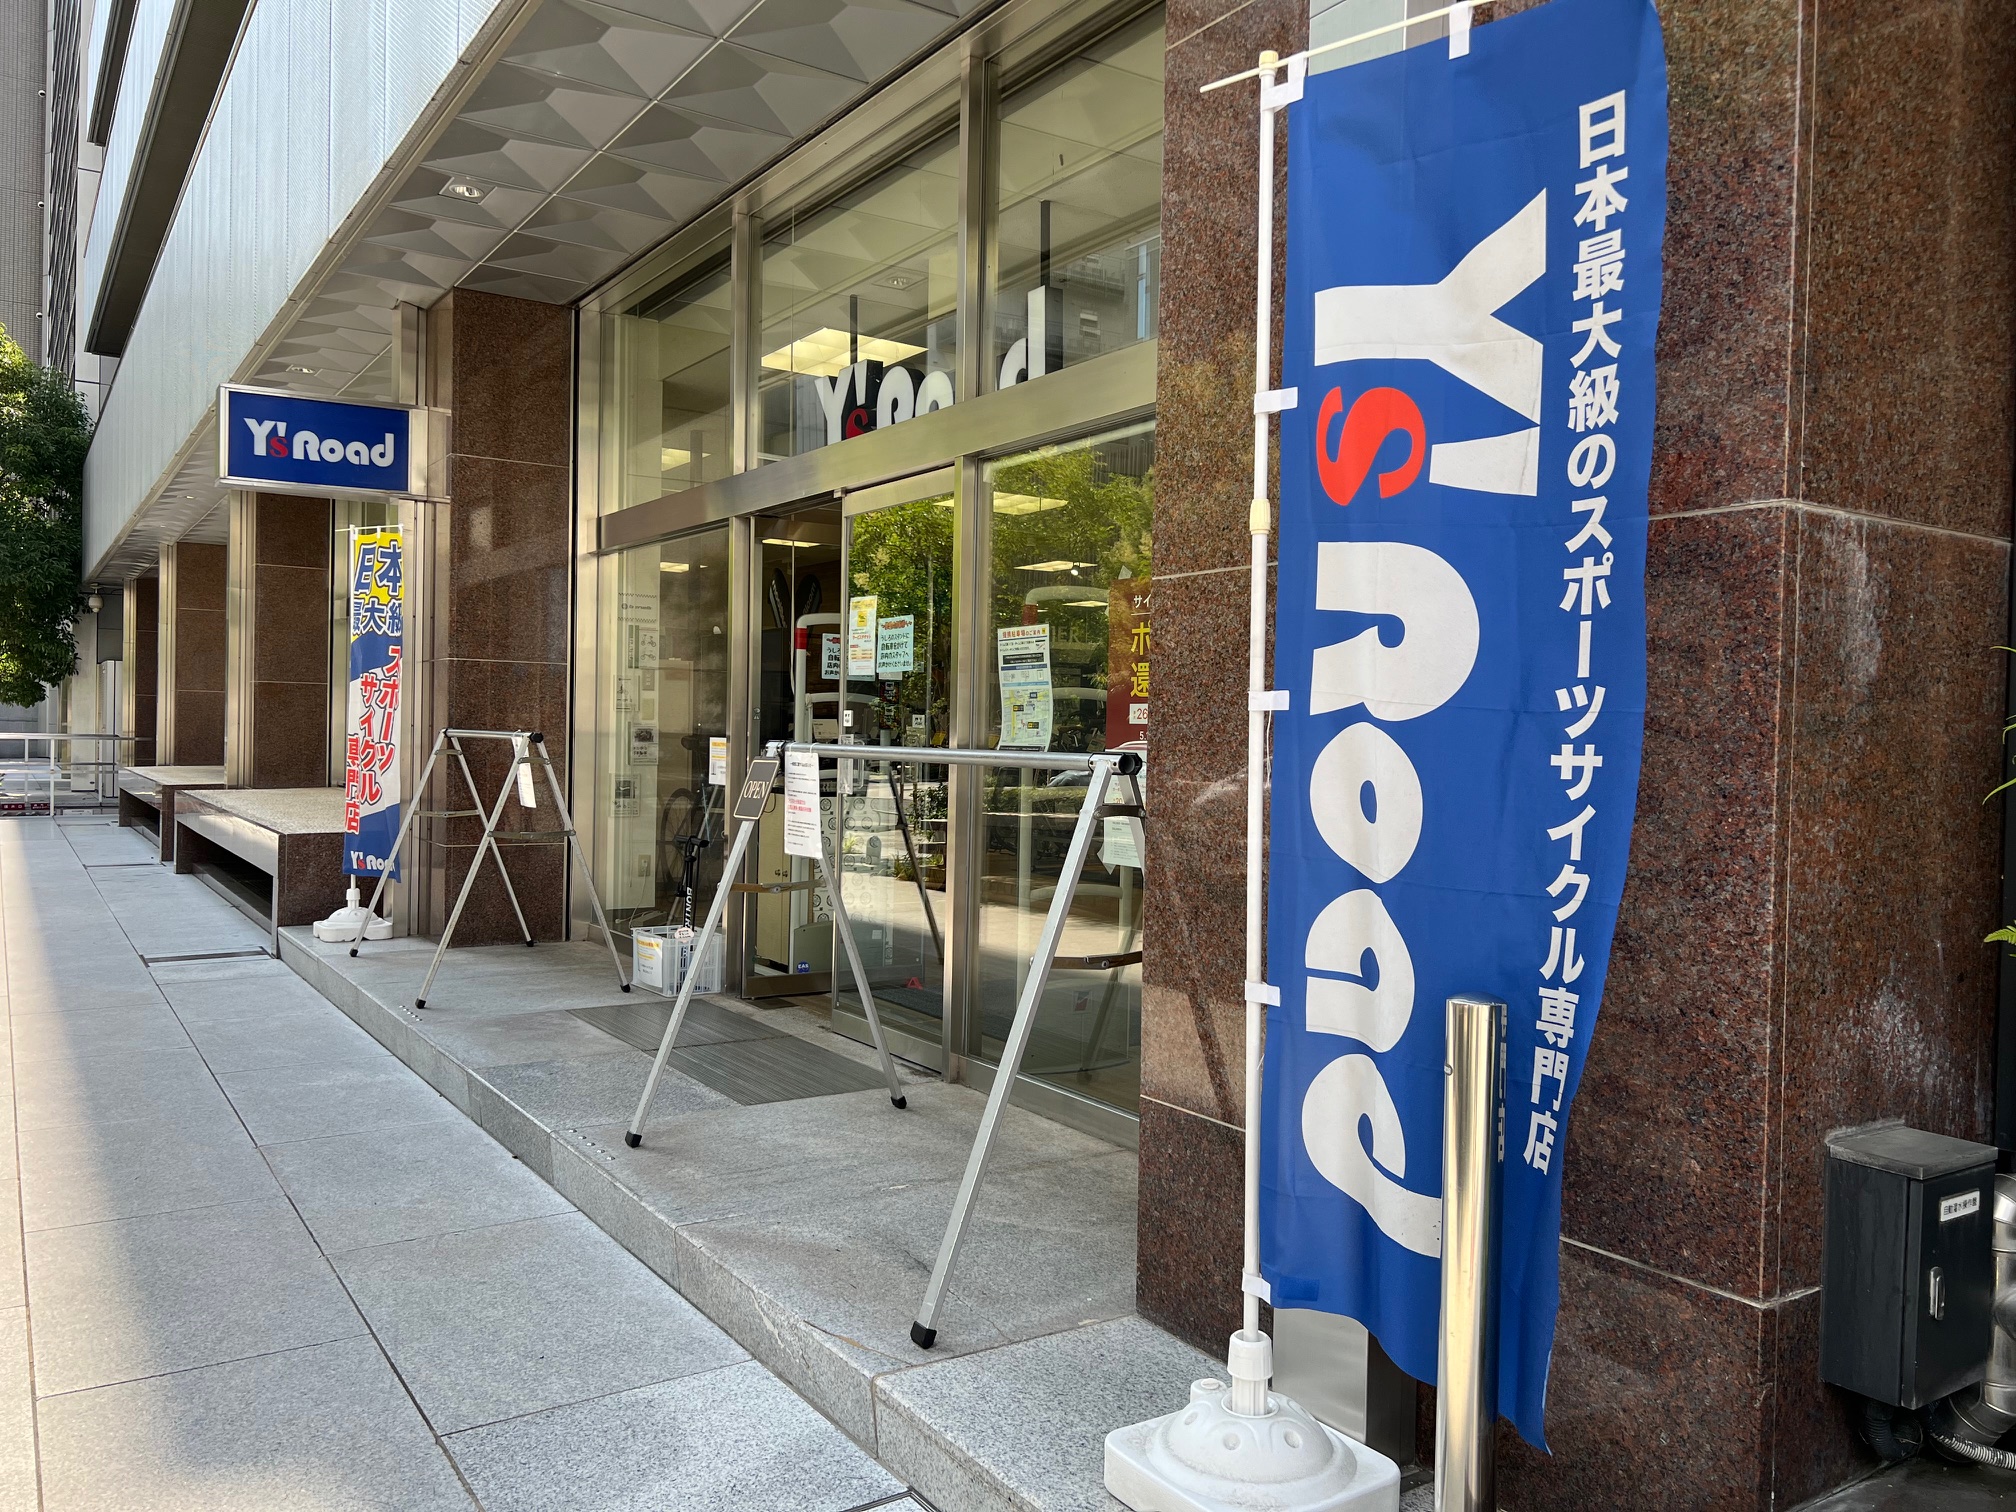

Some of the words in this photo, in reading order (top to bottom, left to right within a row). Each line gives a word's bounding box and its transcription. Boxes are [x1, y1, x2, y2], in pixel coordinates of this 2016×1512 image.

[877, 285, 1046, 430] Rod
[1314, 187, 1547, 506] Y's
[243, 417, 288, 458] Y's
[293, 430, 395, 467] Road
[354, 540, 402, 596] 日本
[1523, 89, 1628, 1175] 日本最大級のスポーツサイクル専門店
[358, 672, 382, 807] サイクル
[743, 780, 770, 799] OPEN
[350, 850, 366, 870] Y's
[1302, 541, 1480, 1257] Road
